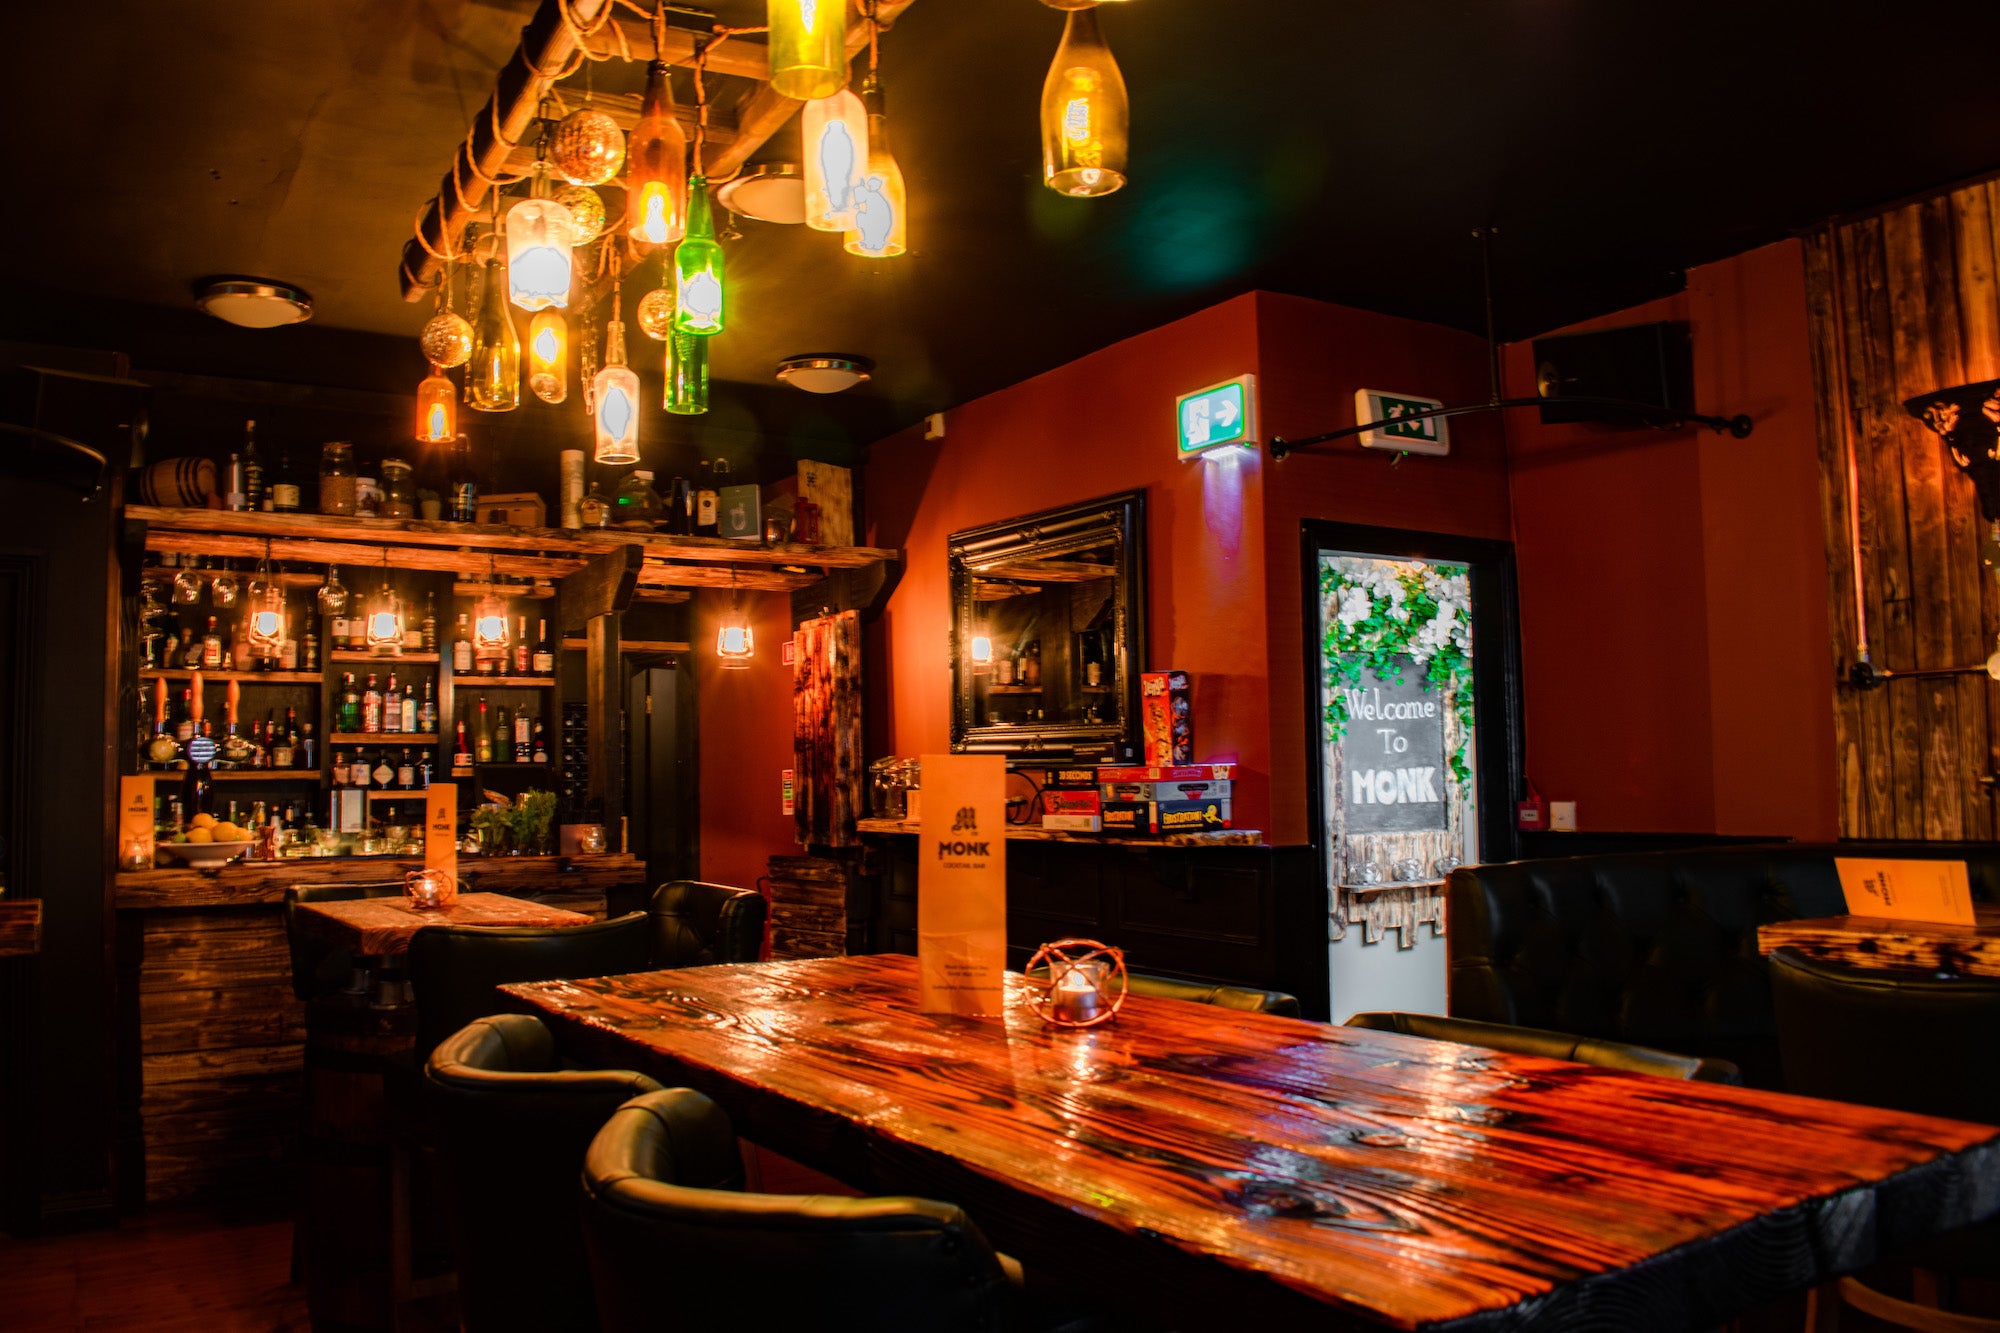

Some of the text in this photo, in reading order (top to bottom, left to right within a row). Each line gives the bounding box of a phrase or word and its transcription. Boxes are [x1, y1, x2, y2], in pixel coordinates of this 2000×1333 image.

[1343, 687, 1436, 720] Welcome
[1376, 728, 1408, 754] To
[1351, 766, 1439, 805] MONK
[938, 841, 990, 860] MONK
